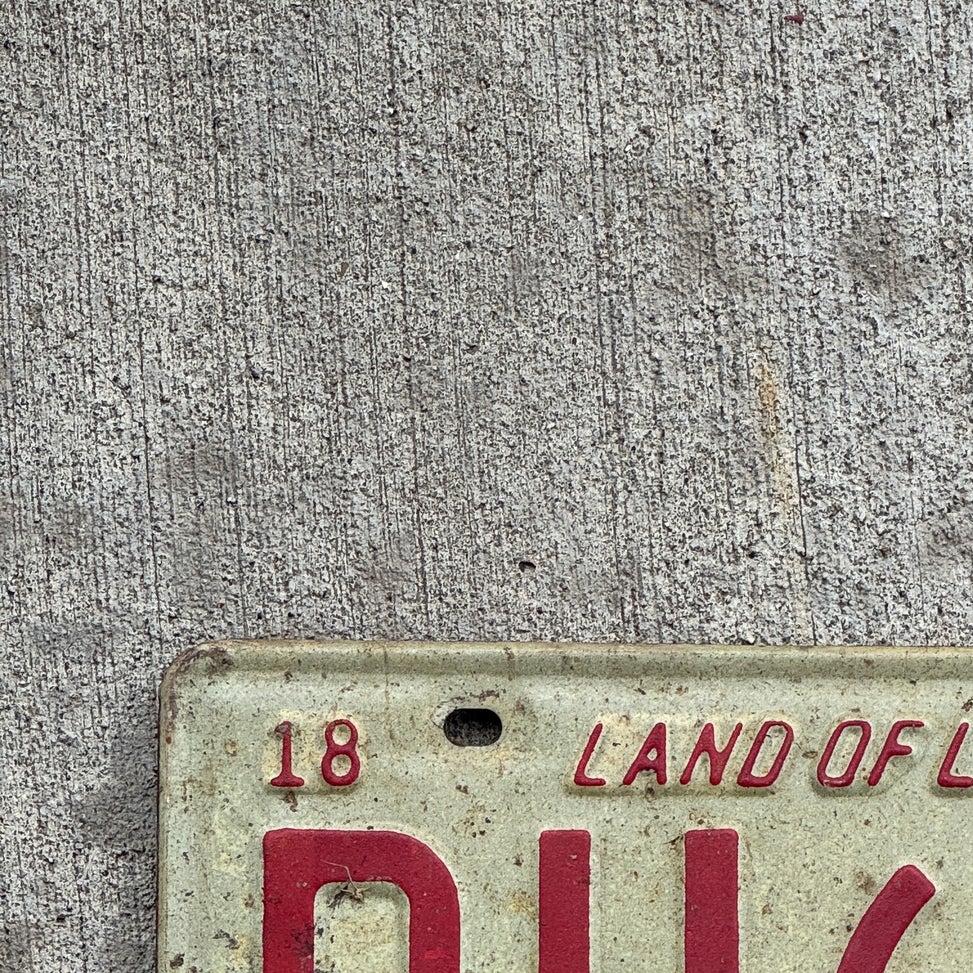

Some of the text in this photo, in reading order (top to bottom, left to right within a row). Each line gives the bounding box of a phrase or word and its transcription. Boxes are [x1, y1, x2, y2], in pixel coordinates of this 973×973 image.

[268, 718, 362, 789] 18
[573, 720, 796, 790] LAND
[816, 719, 926, 789] OF
